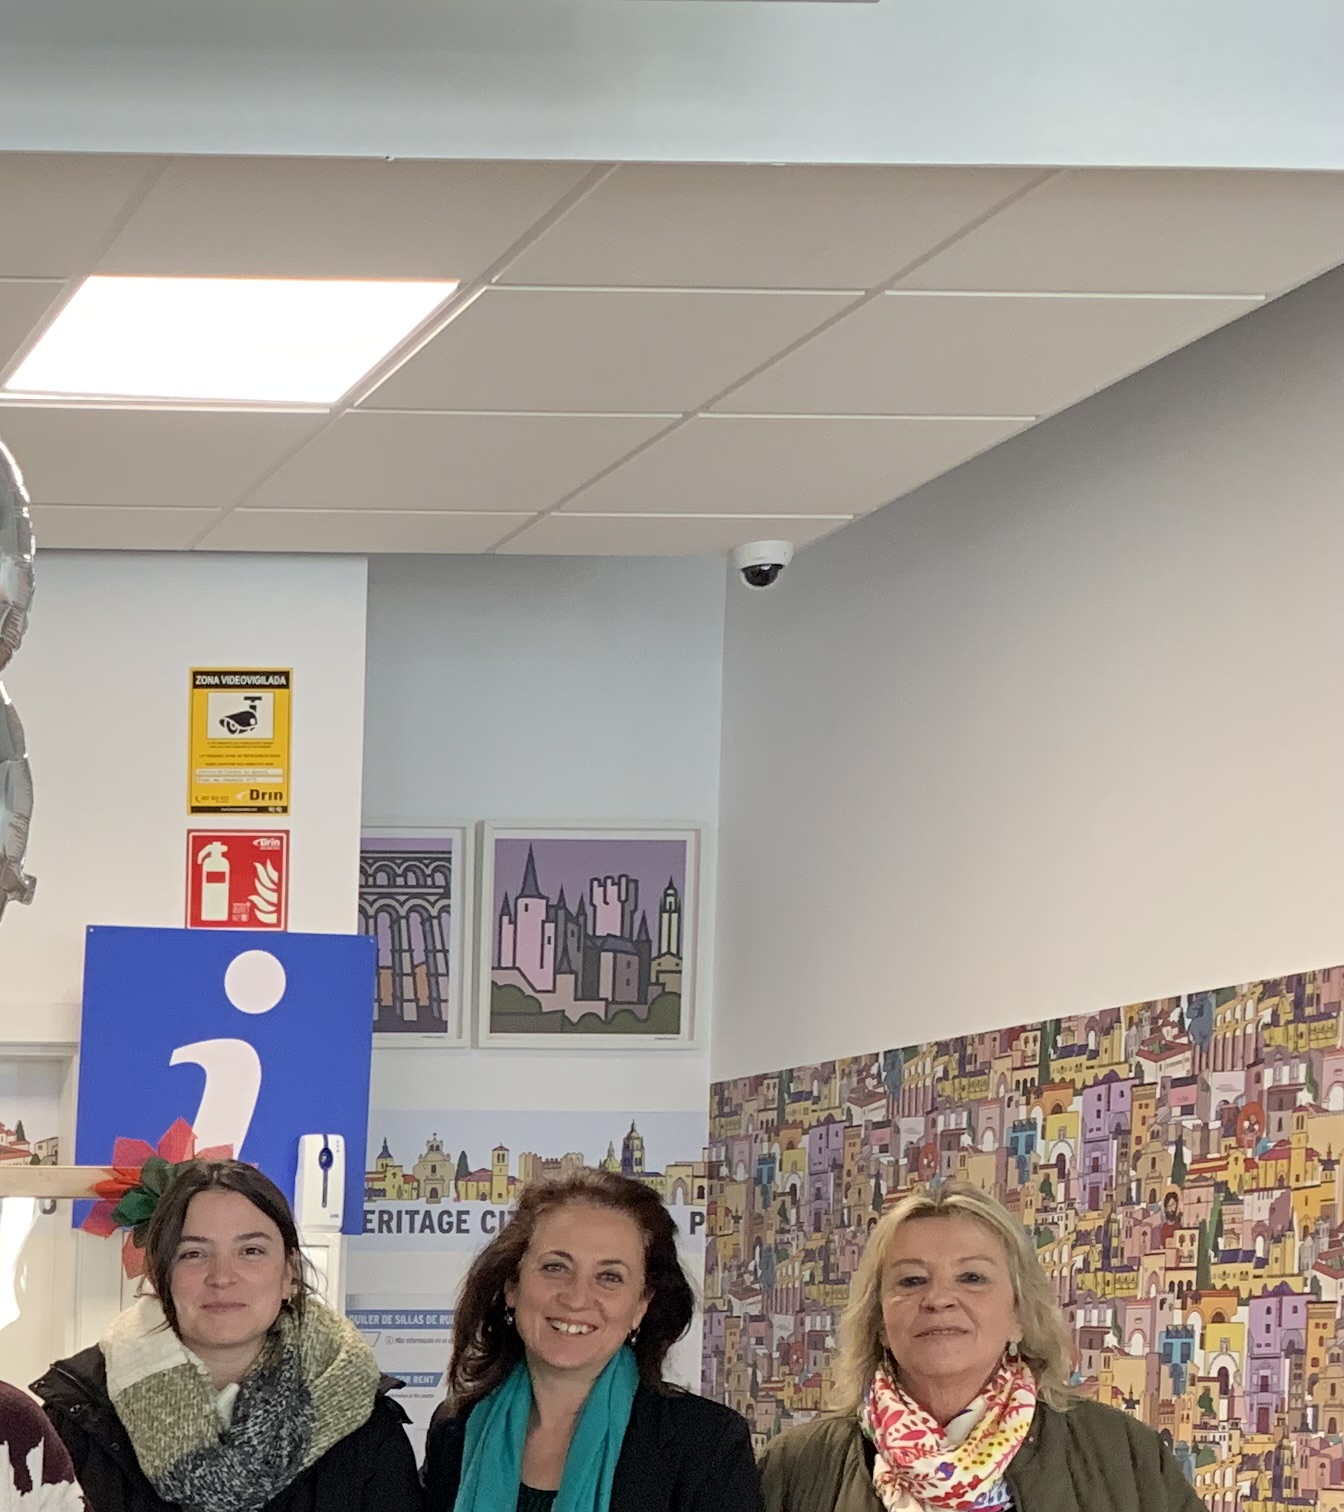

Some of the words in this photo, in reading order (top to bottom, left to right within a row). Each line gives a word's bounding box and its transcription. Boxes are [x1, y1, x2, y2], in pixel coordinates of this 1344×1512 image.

[195, 674, 220, 685] ZONA
[221, 674, 287, 686] VIDEOVIGILADA
[249, 788, 283, 801] Drin
[363, 1209, 470, 1235] ERITAGE
[349, 1314, 380, 1326] QUILER
[381, 1314, 393, 1326] DE
[395, 1314, 424, 1325] SILLAS
[426, 1314, 438, 1325] DE
[413, 1375, 435, 1384] RENT
